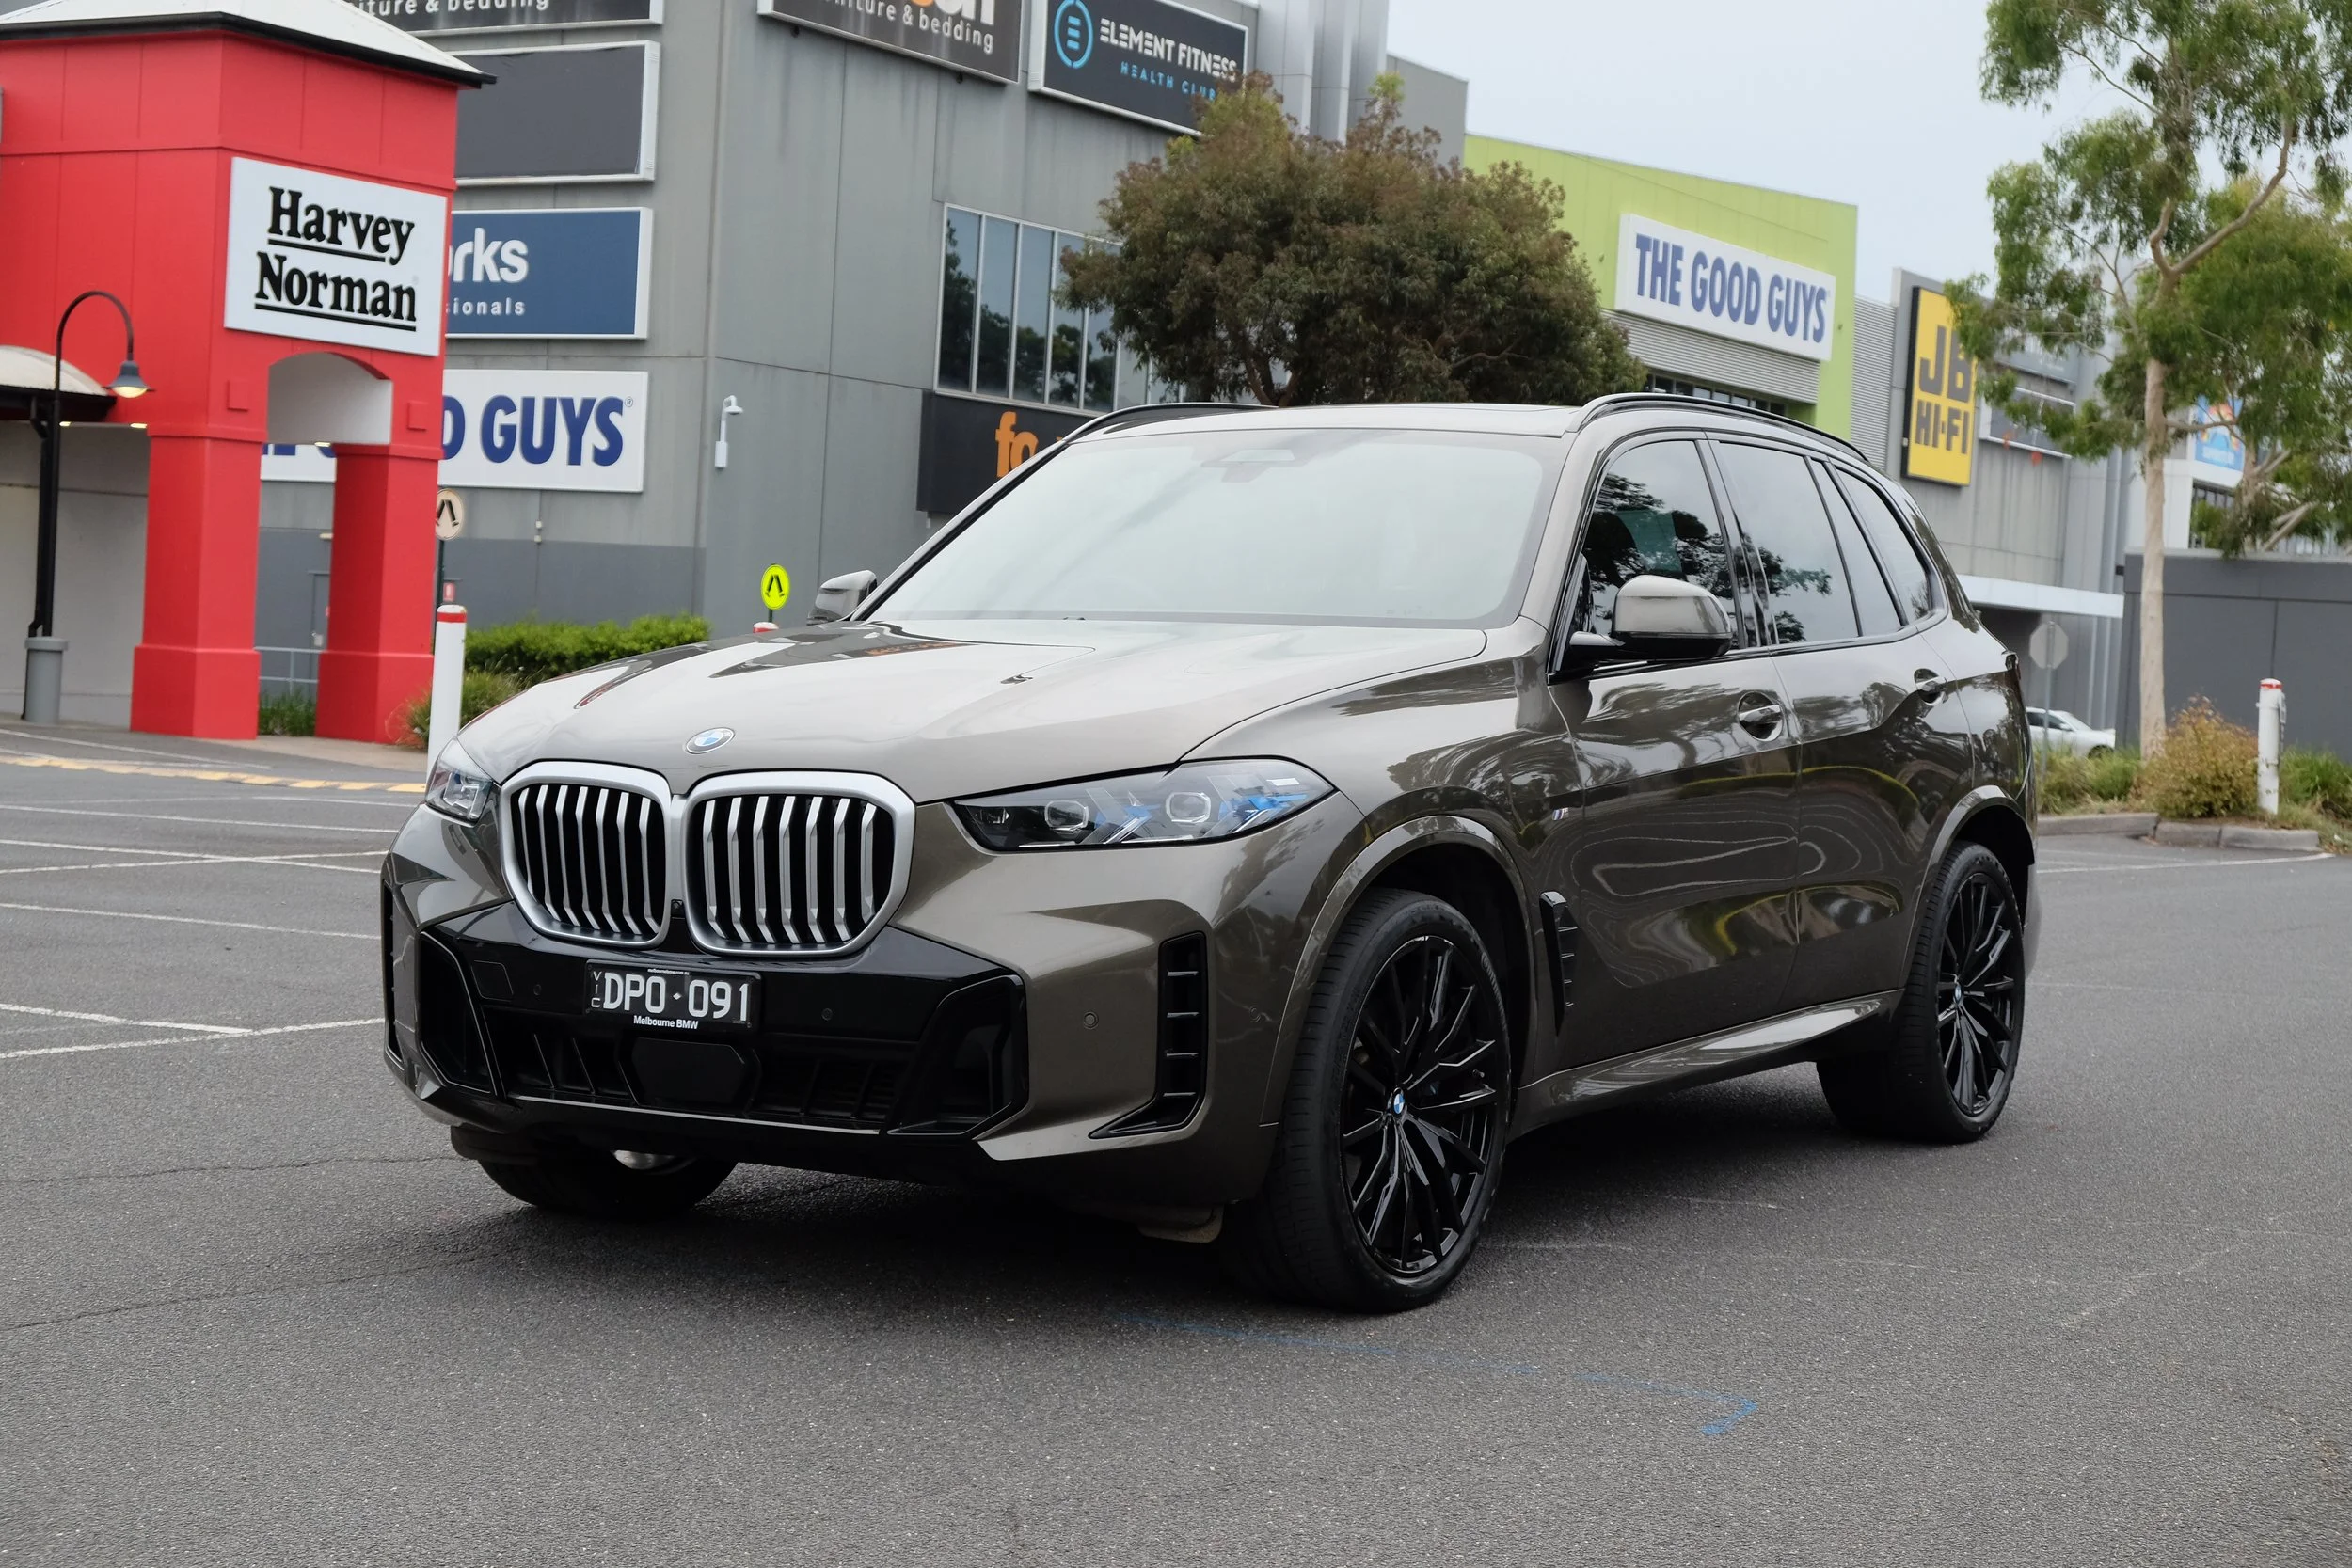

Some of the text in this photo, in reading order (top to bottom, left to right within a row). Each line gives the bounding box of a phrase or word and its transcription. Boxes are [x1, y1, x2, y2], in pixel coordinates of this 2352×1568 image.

[425, 0, 440, 13] &
[902, 9, 914, 25] &
[918, 9, 994, 55] bedding
[1099, 17, 1238, 83] ELEMENT FITNESS
[1120, 61, 1216, 103] HEALTH CLUB
[267, 185, 416, 266] Harvey
[449, 227, 529, 283] rks
[254, 250, 417, 323] Norman
[446, 297, 526, 316] ionals
[1635, 232, 1827, 344] THE GOOD GUYS
[1918, 325, 1973, 404] JB
[480, 394, 624, 467] GUYS
[633, 1014, 699, 1030] Melbourne BMW
